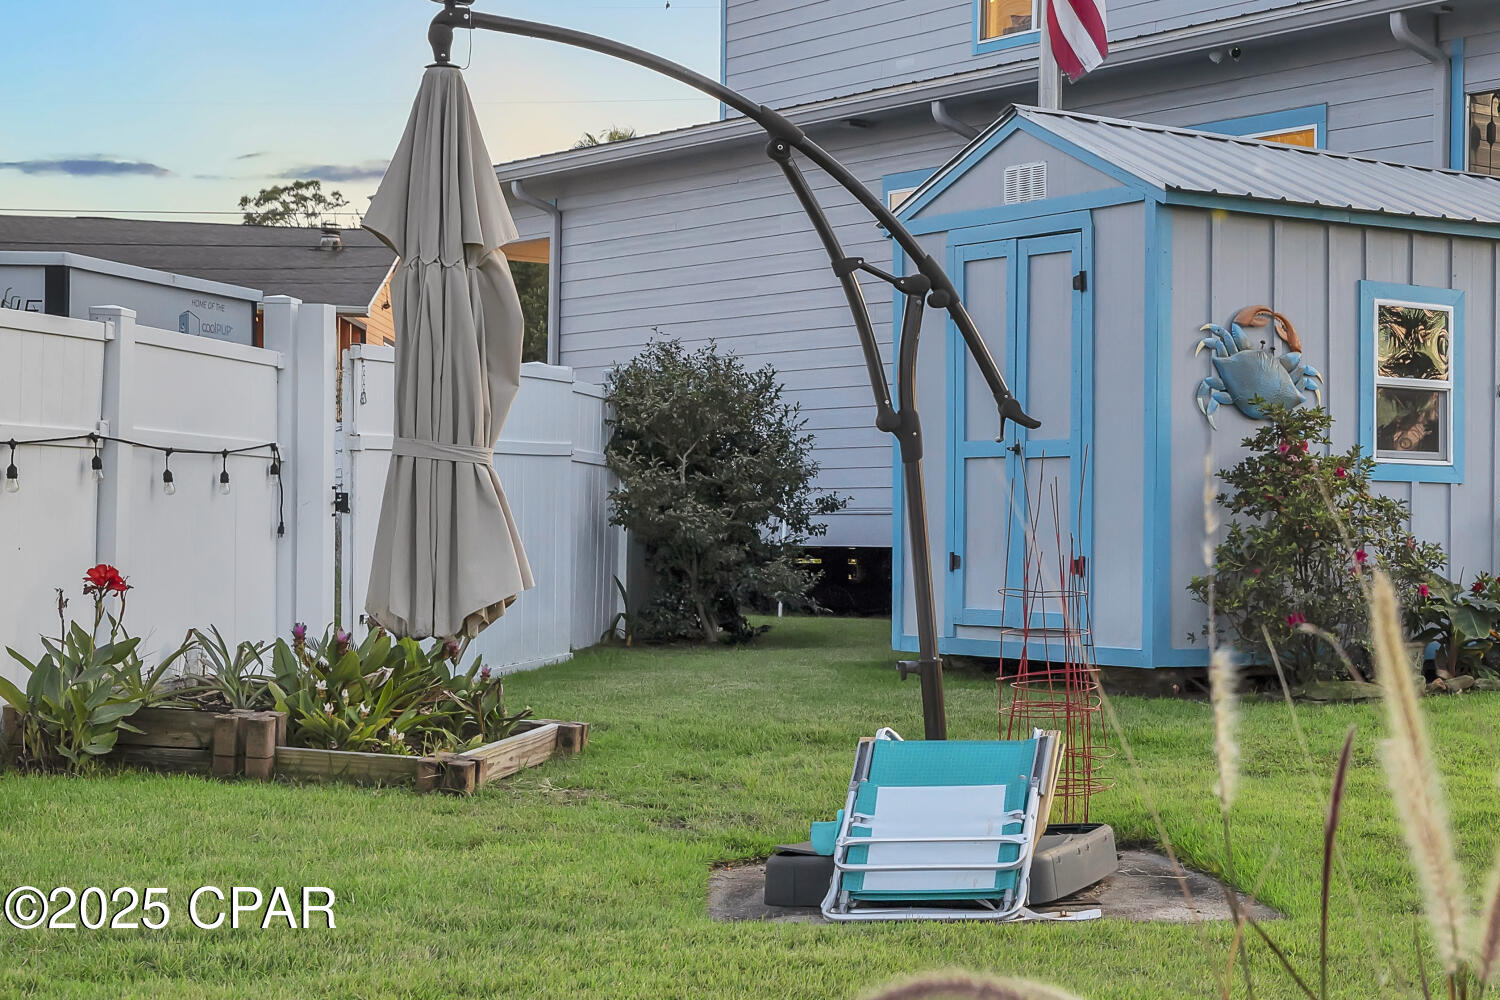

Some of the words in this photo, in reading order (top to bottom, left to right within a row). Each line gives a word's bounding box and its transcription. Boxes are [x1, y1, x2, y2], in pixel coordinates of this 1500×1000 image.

[191, 299, 207, 309] HOME
[207, 301, 215, 310] OF
[216, 302, 225, 312] THE
